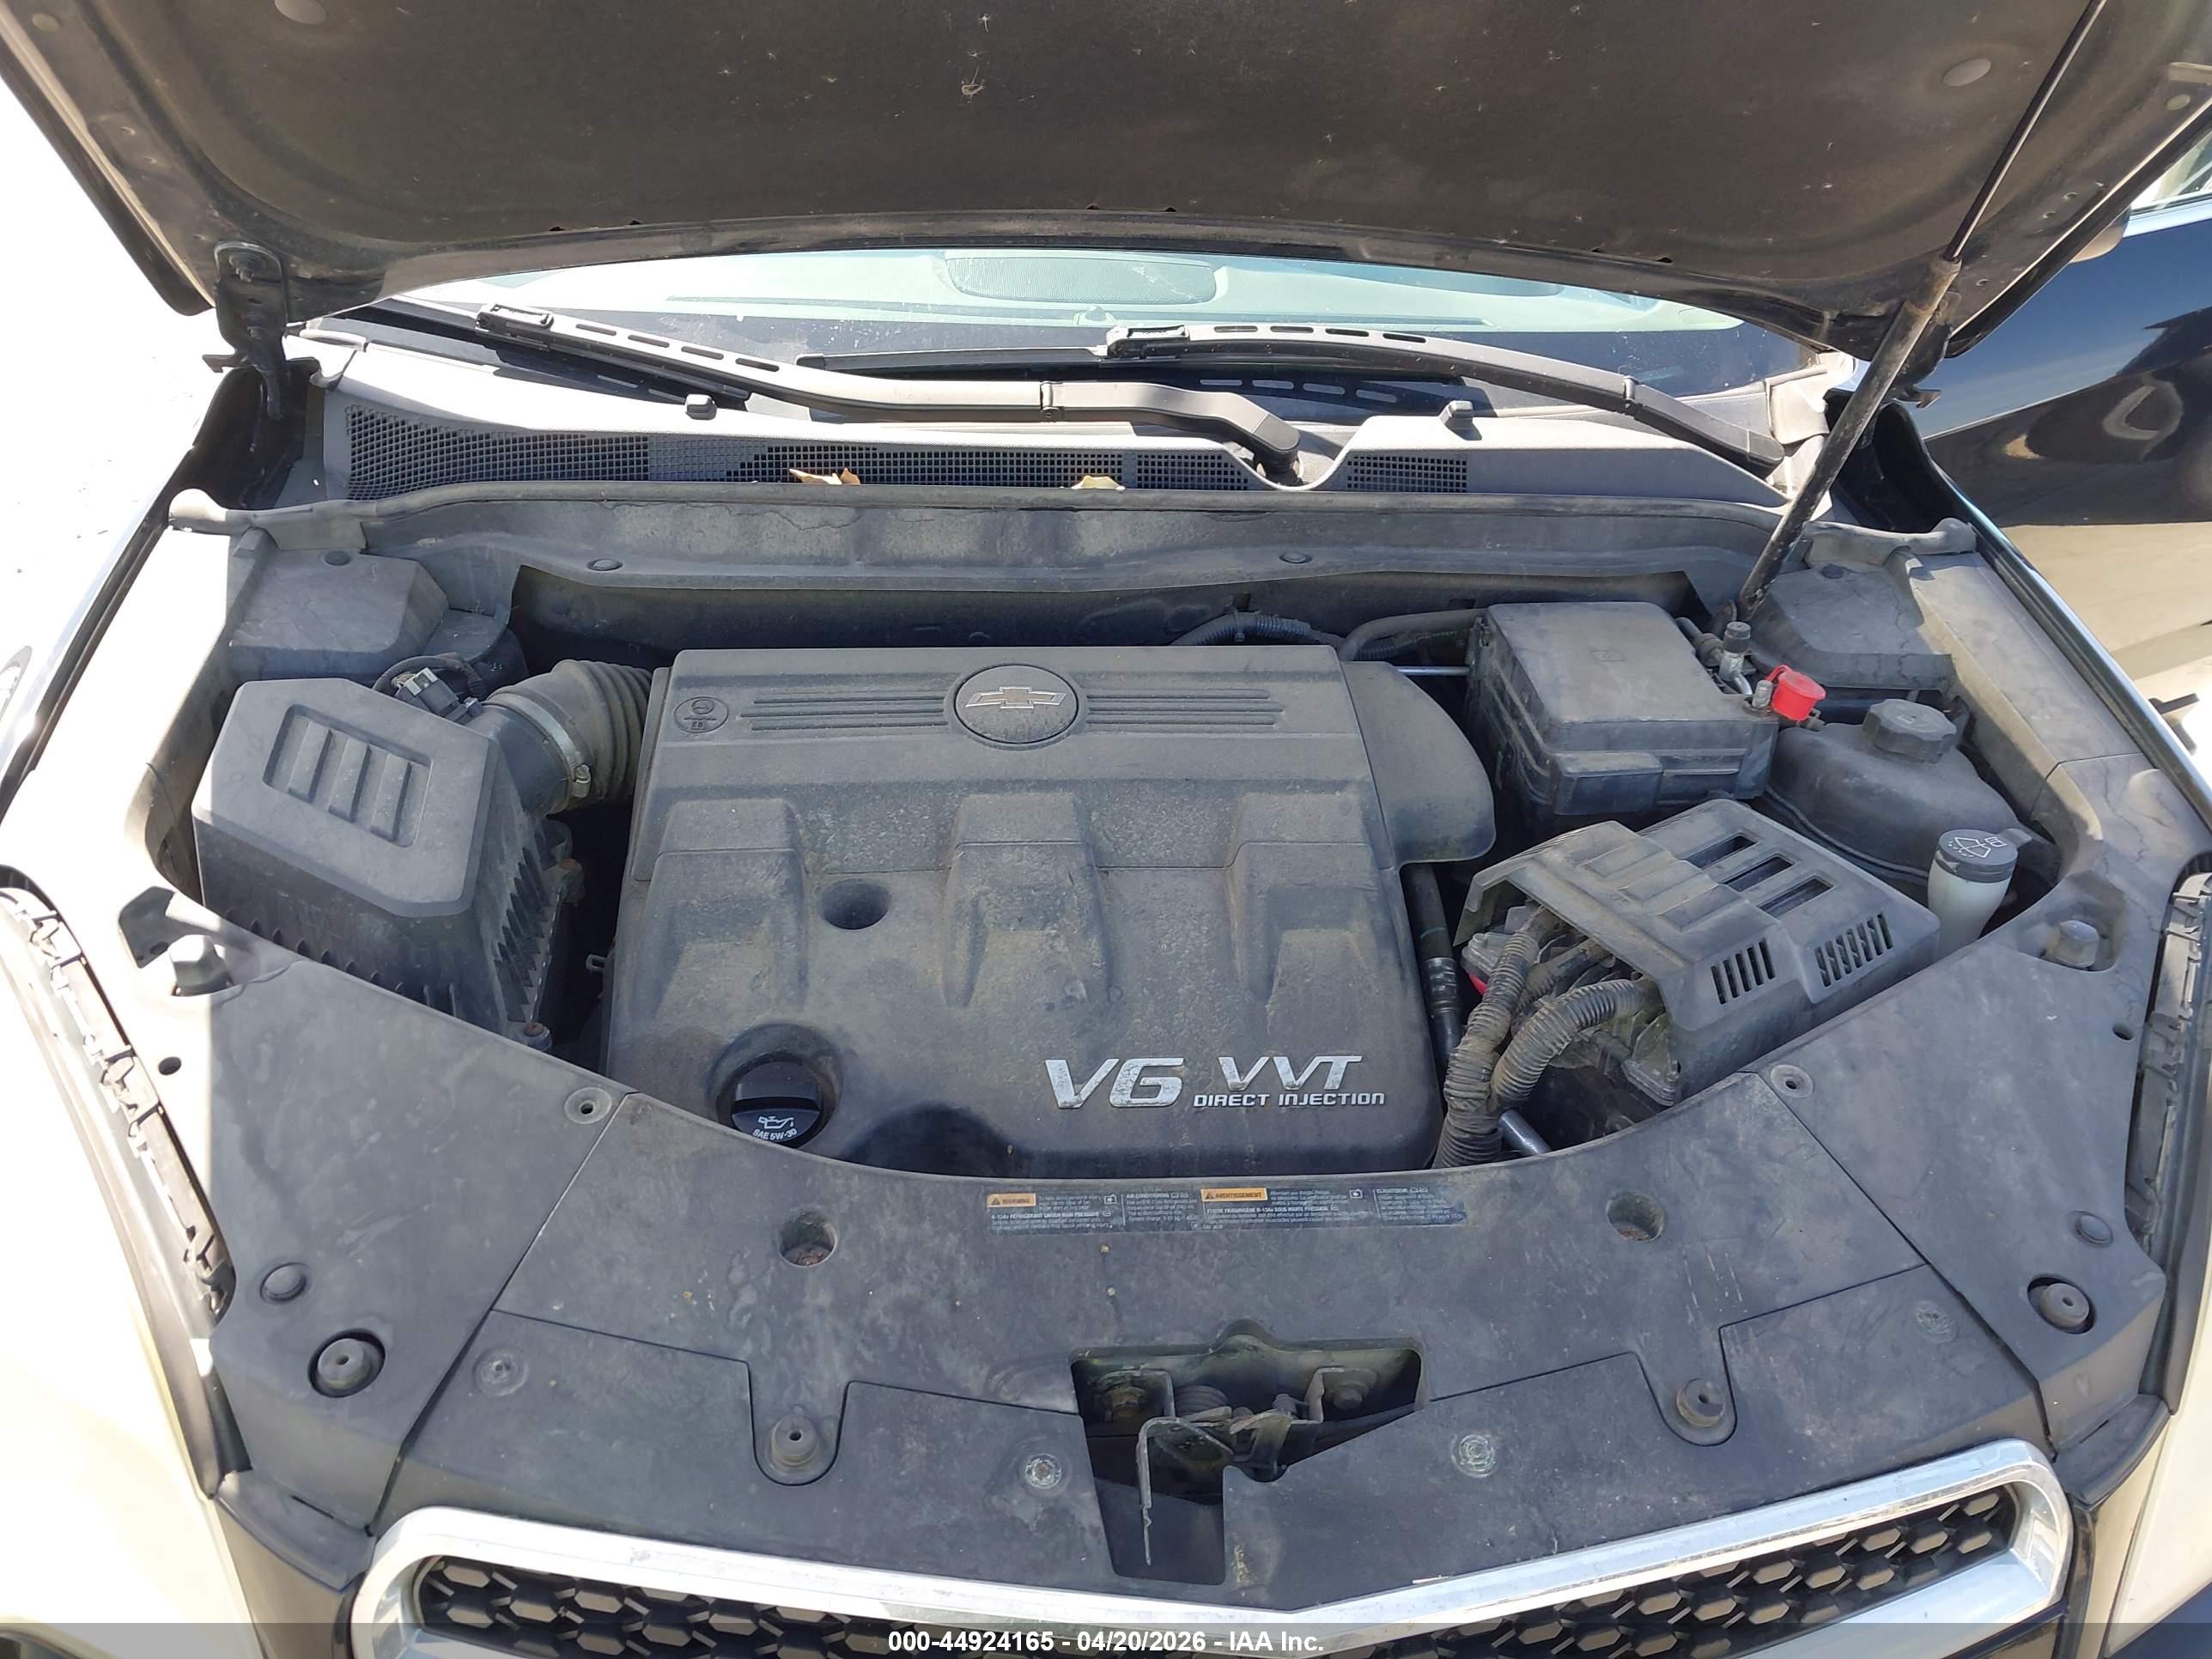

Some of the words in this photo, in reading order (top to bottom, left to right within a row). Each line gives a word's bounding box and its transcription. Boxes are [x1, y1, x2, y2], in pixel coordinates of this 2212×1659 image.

[1045, 1057, 1185, 1109] V6
[1218, 1055, 1363, 1091] VVT
[1194, 1093, 1270, 1108] DIRECT
[1279, 1091, 1385, 1107] INJECTION
[752, 1128, 769, 1140] SAE
[769, 1127, 798, 1140] 5W-30
